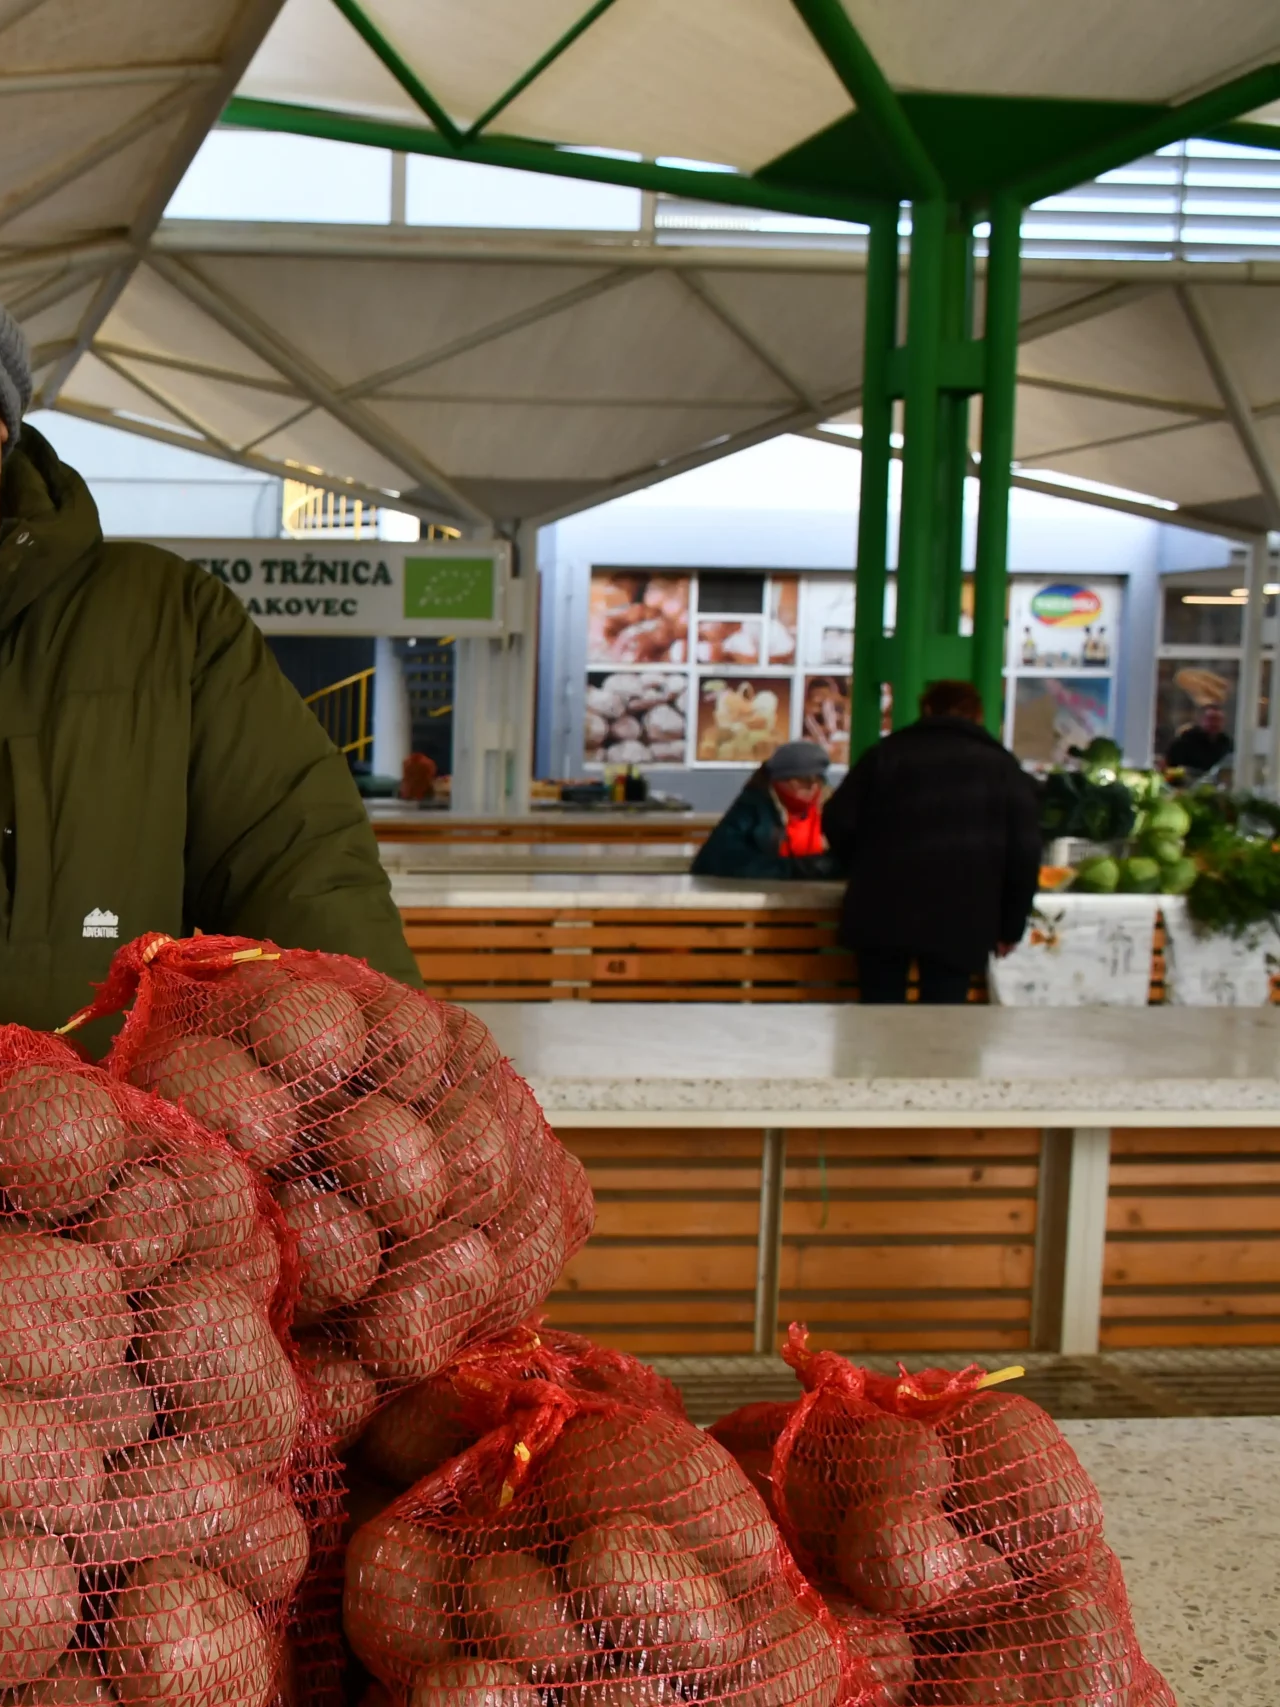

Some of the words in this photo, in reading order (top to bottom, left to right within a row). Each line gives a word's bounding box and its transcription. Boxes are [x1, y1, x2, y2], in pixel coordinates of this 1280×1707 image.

[192, 558, 253, 584] KO
[260, 553, 393, 586] TRŽNICA
[246, 597, 358, 616] AKOVEC
